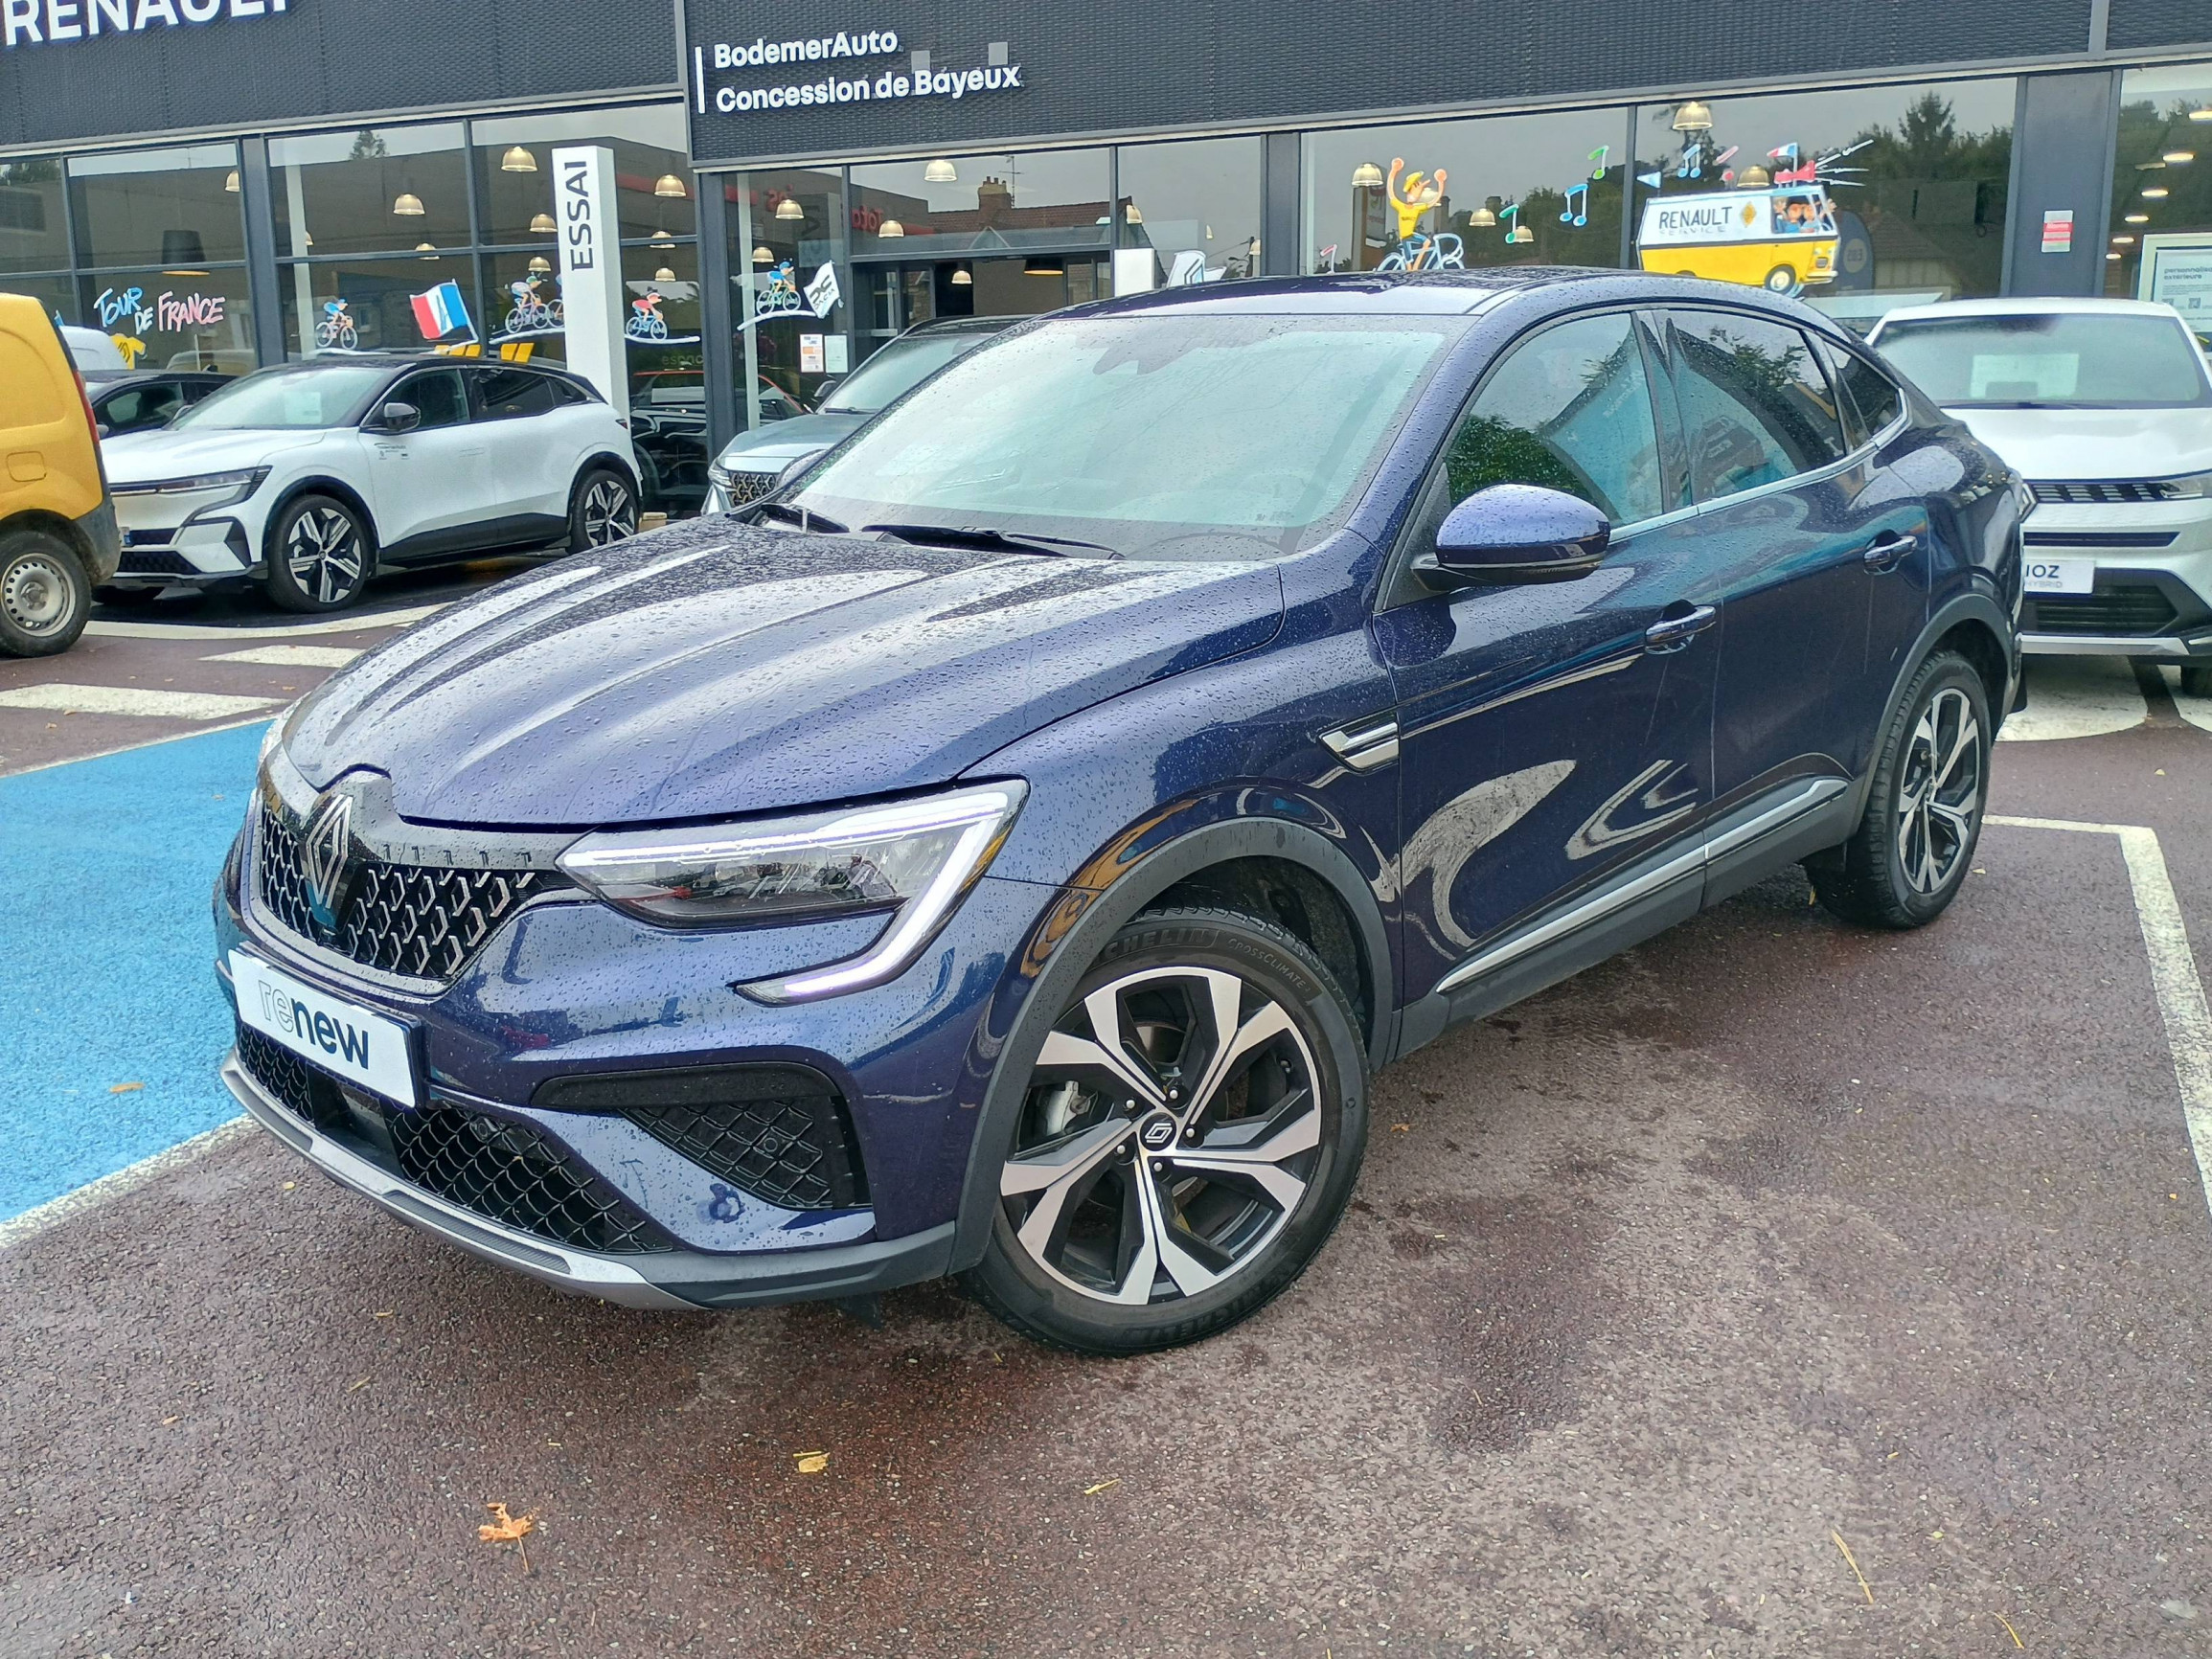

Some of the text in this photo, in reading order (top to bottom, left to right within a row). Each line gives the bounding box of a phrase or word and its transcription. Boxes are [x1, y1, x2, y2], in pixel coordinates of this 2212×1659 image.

[3, 0, 287, 46] RENA
[714, 31, 899, 68] BodemerAuto
[716, 65, 1021, 112] Concession de Bayeux
[563, 161, 594, 271] ESSAI
[1659, 206, 1733, 229] RENAULT
[94, 287, 226, 335] TOUR DE FRANCE
[258, 979, 370, 1071] renew
